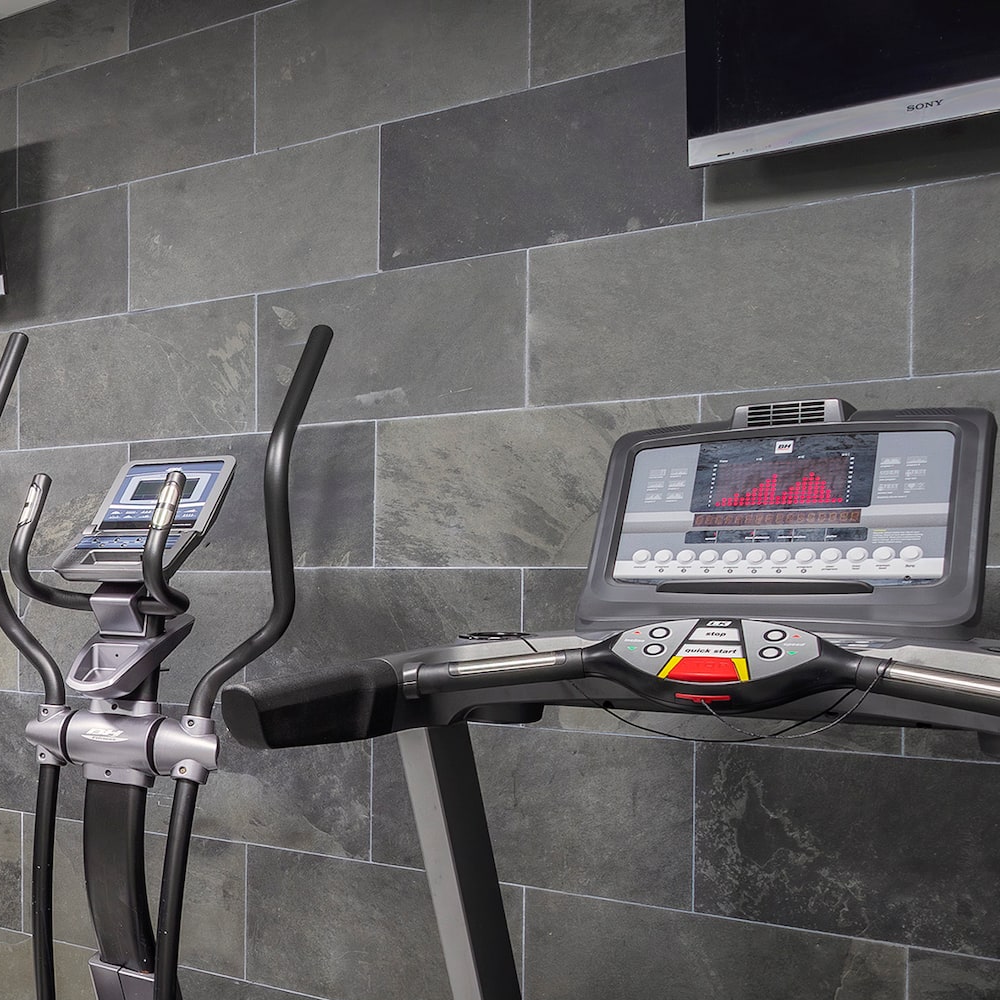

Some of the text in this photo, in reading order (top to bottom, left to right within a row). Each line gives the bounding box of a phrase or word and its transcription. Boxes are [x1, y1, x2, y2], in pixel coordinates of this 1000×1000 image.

[906, 98, 944, 112] SONY
[705, 630, 727, 639] stop
[684, 647, 737, 656] quick start
